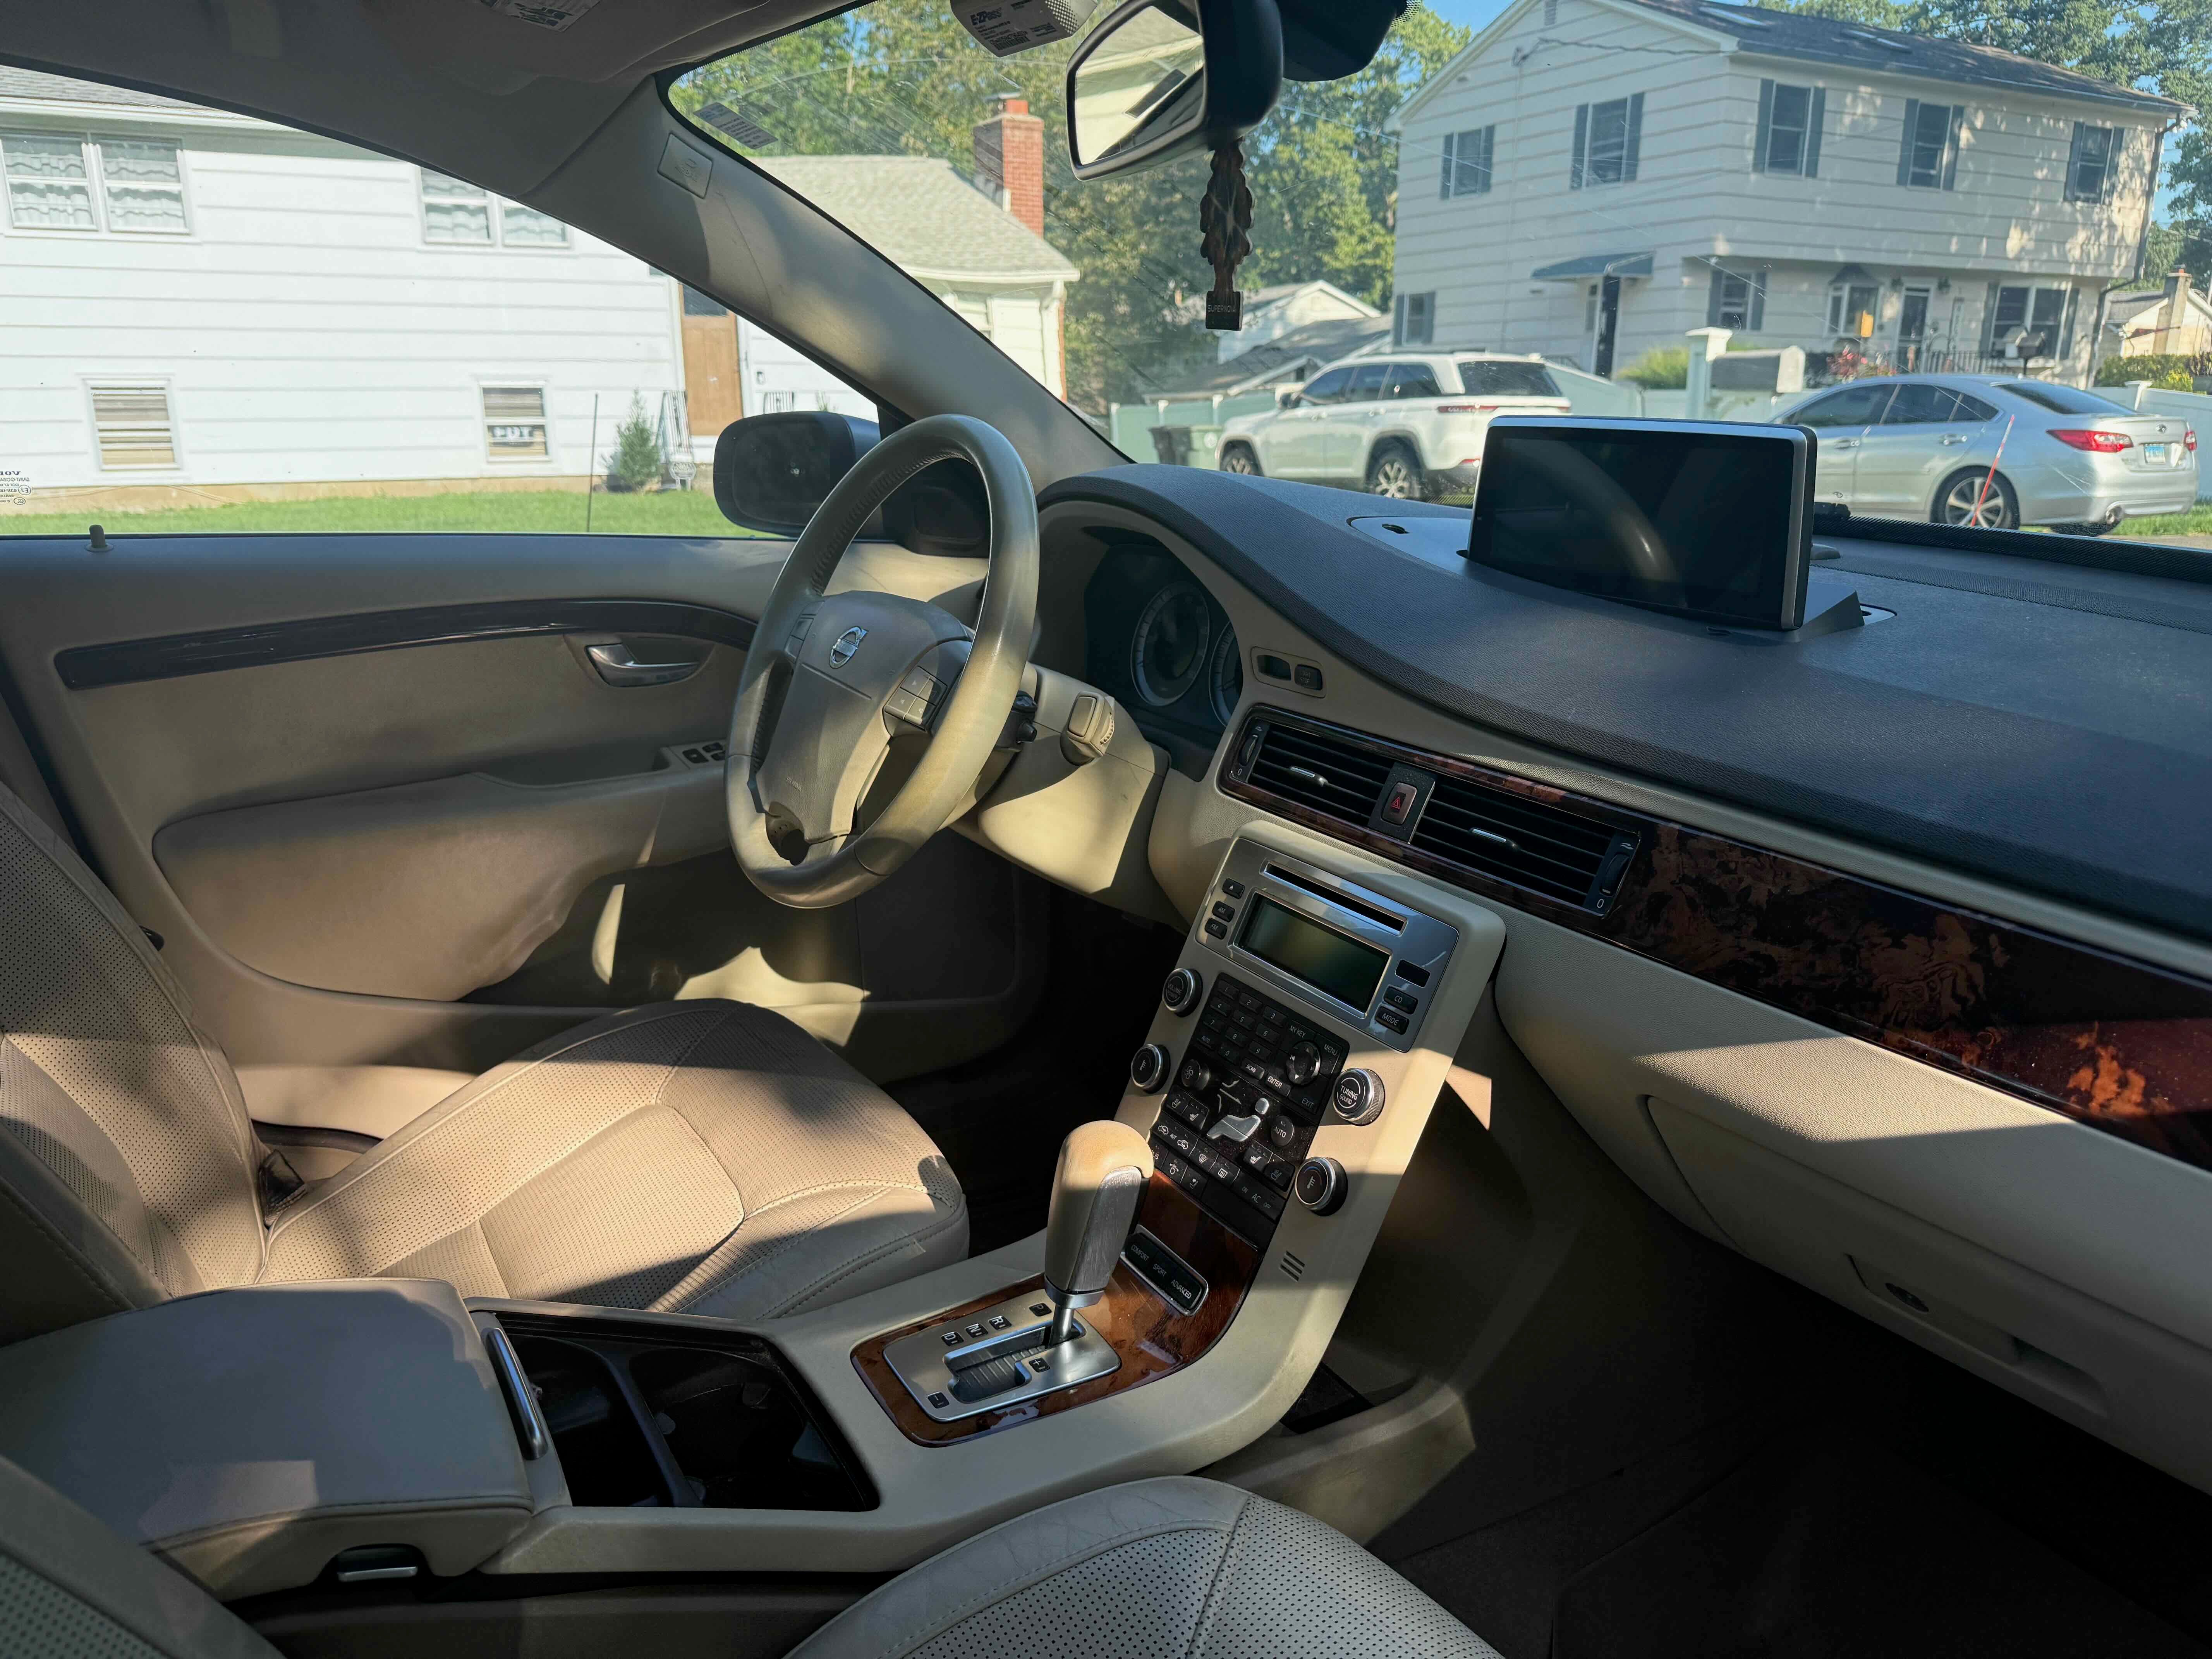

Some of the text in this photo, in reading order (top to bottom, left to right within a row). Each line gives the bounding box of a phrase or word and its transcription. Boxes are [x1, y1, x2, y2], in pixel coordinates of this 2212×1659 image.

[1394, 995, 1403, 1004] CD
[1382, 1013, 1398, 1026] MODE
[1289, 1025, 1306, 1038] MY KEY
[1323, 1044, 1338, 1056] MENU
[1246, 1064, 1257, 1073] SCAN
[1267, 1075, 1283, 1089] ENTER
[1340, 1085, 1358, 1100] TUNING
[1302, 1097, 1315, 1109] EXIT
[1339, 1094, 1352, 1104] SOUND
[1274, 1126, 1286, 1138] AUTO
[1251, 1193, 1261, 1203] AC
[1131, 1244, 1150, 1261] COMFORT
[1152, 1264, 1167, 1277] SPORT
[1171, 1279, 1192, 1299] ADVANCED
[1035, 1304, 1044, 1313] P
[991, 1316, 1003, 1325] R
[966, 1323, 980, 1333] N
[942, 1332, 956, 1341] D
